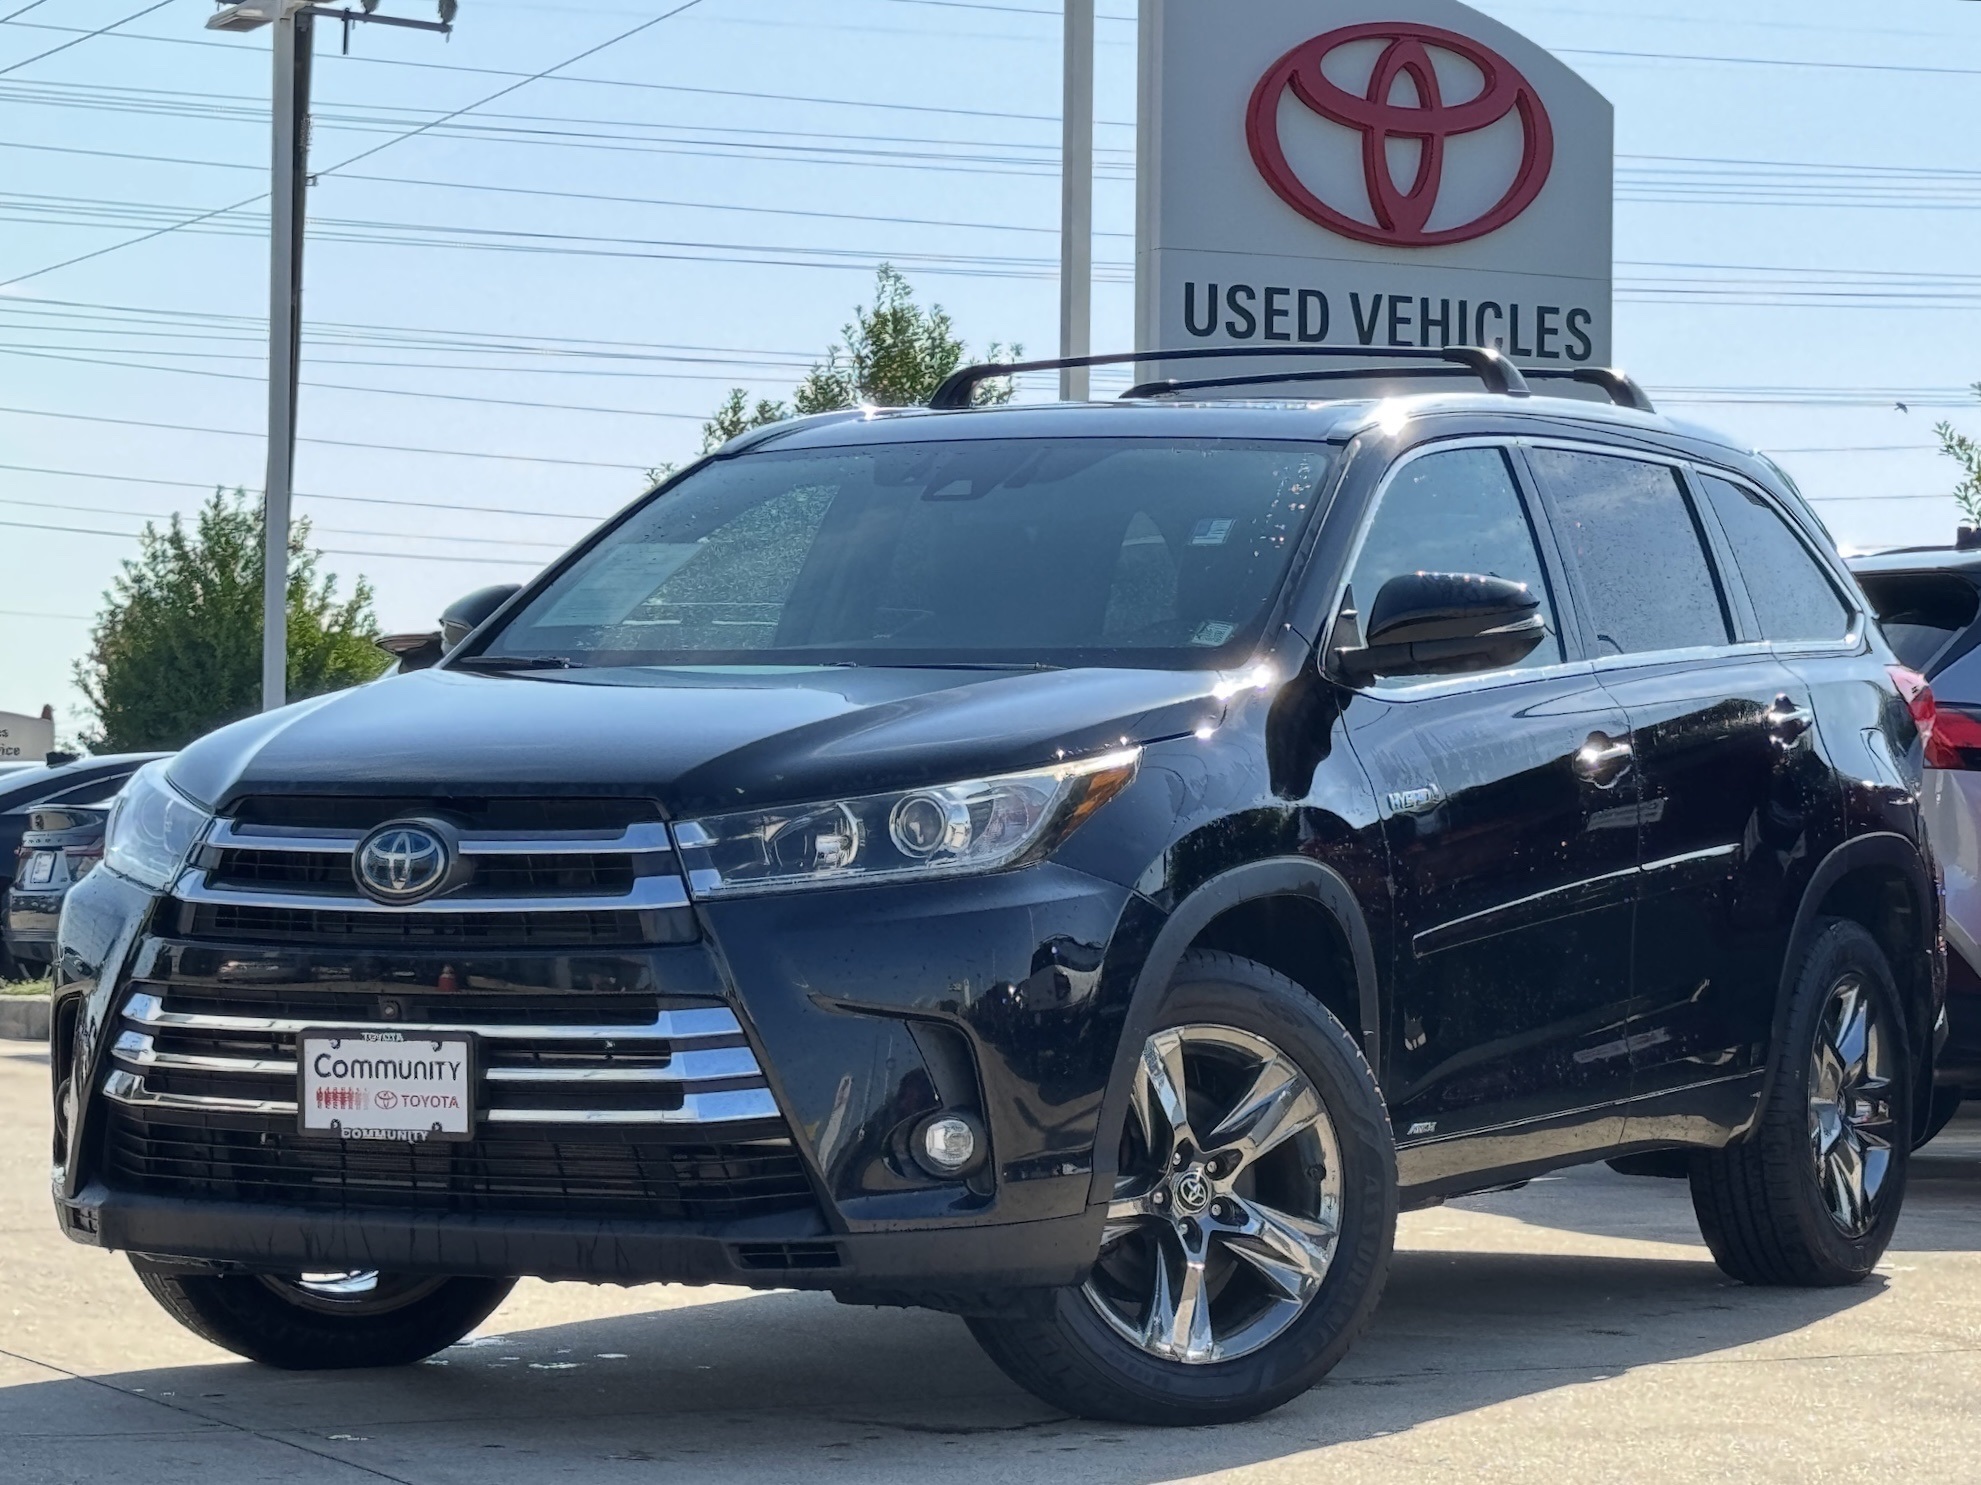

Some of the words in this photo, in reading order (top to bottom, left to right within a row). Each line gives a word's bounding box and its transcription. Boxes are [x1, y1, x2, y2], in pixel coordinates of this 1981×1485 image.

[1185, 281, 1330, 343] USED
[1348, 291, 1592, 362] VEHICLES
[400, 1094, 460, 1109] TOYOTA
[340, 1128, 430, 1143] COMMUNITY
